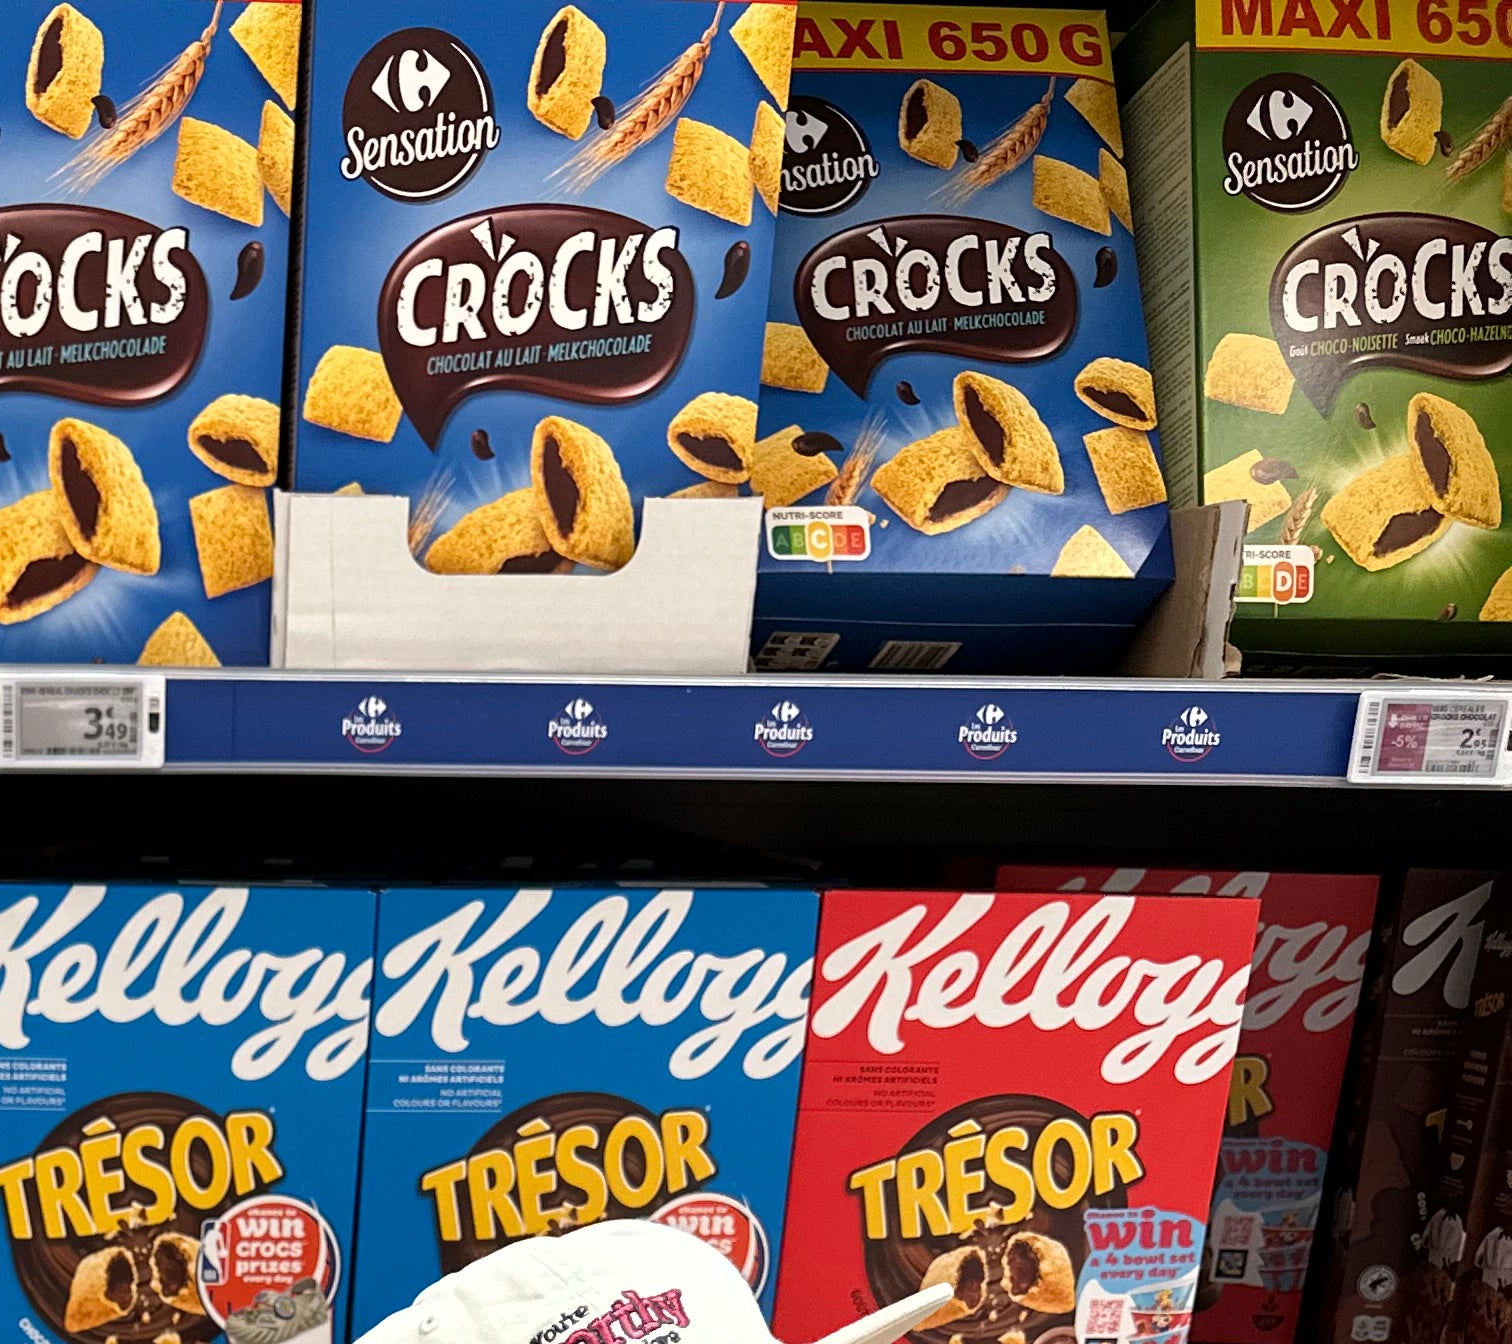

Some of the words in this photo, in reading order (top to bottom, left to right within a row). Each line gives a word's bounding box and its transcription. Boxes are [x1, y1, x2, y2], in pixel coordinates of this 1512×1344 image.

[1221, 0, 1392, 41] MAXI
[341, 113, 500, 180] Sensation
[1223, 140, 1358, 195] Sensation
[846, 321, 903, 343] CHOCOLAT
[908, 320, 923, 335] AU
[925, 317, 947, 333] LAIT
[953, 311, 1045, 331] MELKCHOCOLADE
[6, 346, 25, 369] AU
[27, 343, 54, 367] LAIT
[60, 336, 167, 363] MELKCHOCOLADE
[427, 348, 492, 376] CHOCOLAT
[495, 347, 513, 368] AU
[515, 344, 541, 366] LAIT
[548, 334, 652, 362] MELKCHOCOLADE
[1310, 334, 1398, 356] CHOCO-NOISETTE
[772, 511, 844, 521] NUTRI-SCORE
[342, 717, 401, 741] Produits
[548, 718, 607, 742] Produits
[754, 721, 813, 744] Produits
[958, 724, 1018, 746] Produits
[1161, 726, 1221, 749] Produits
[848, 1112, 1145, 1241] TRÉSOR
[236, 1217, 306, 1239] win
[1087, 1209, 1194, 1252] win
[236, 1240, 303, 1259] crocs
[1122, 1252, 1164, 1266] bowl
[236, 1258, 303, 1277] prizes
